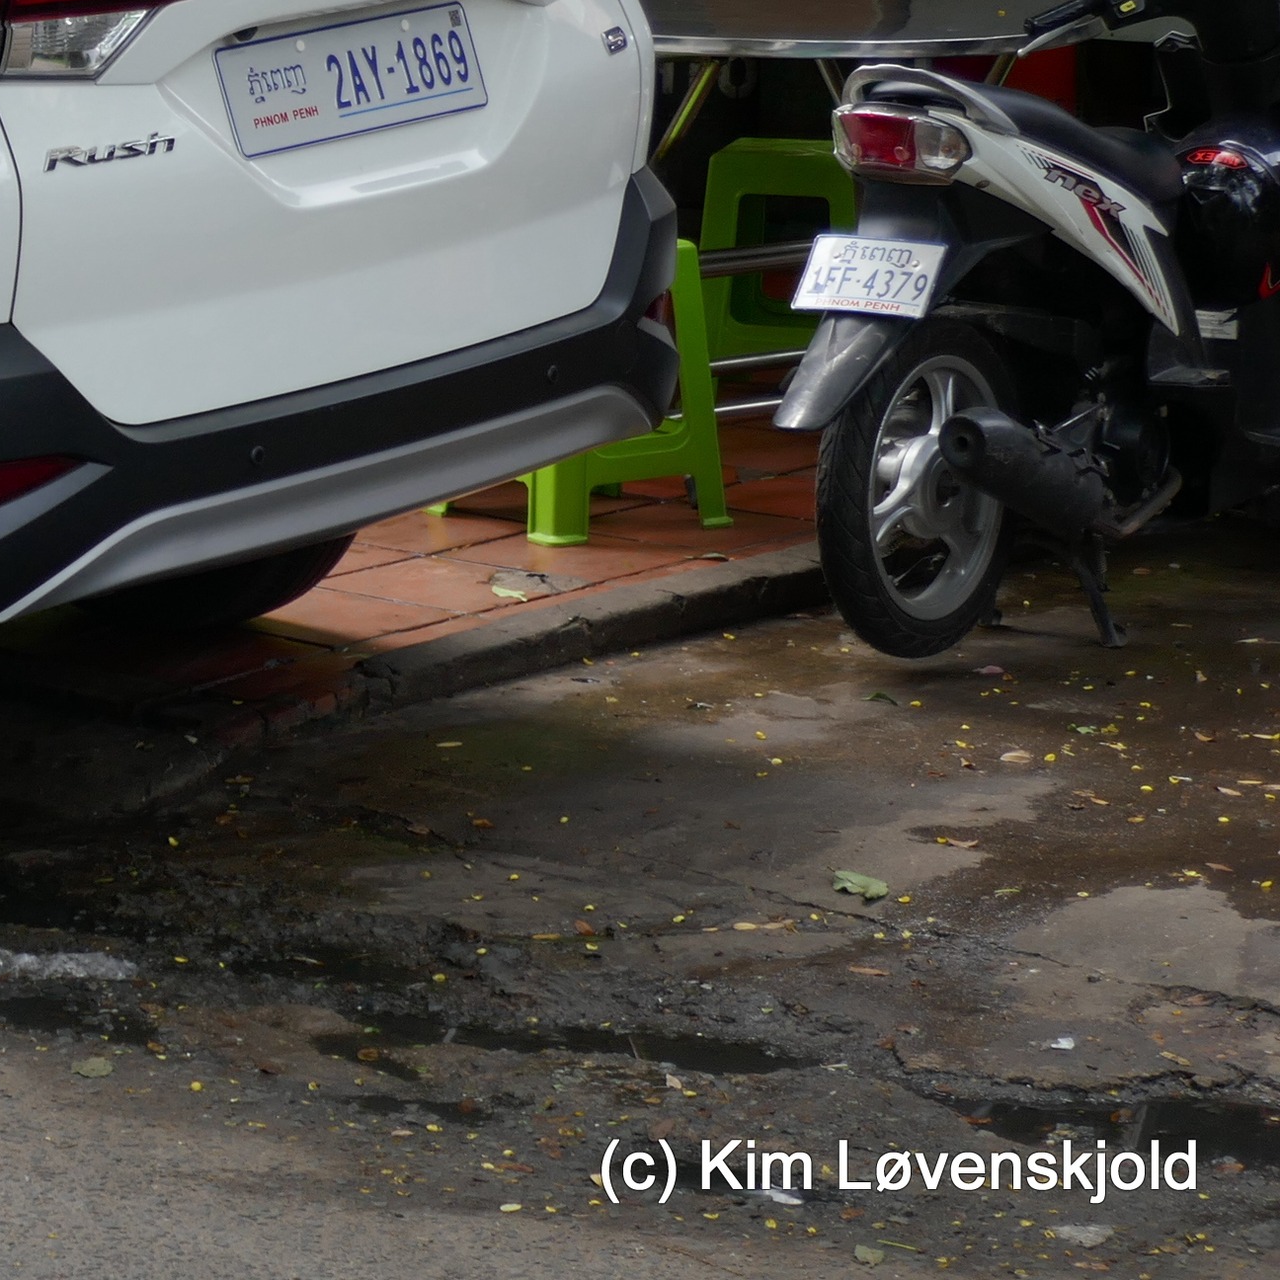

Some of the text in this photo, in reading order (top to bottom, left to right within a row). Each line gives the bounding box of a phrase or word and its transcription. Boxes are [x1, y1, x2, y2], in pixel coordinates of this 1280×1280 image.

[326, 29, 469, 109] 2AY-1869
[253, 105, 320, 129] PHNOM PENH
[42, 131, 176, 172] Rush
[863, 300, 901, 312] PENH
